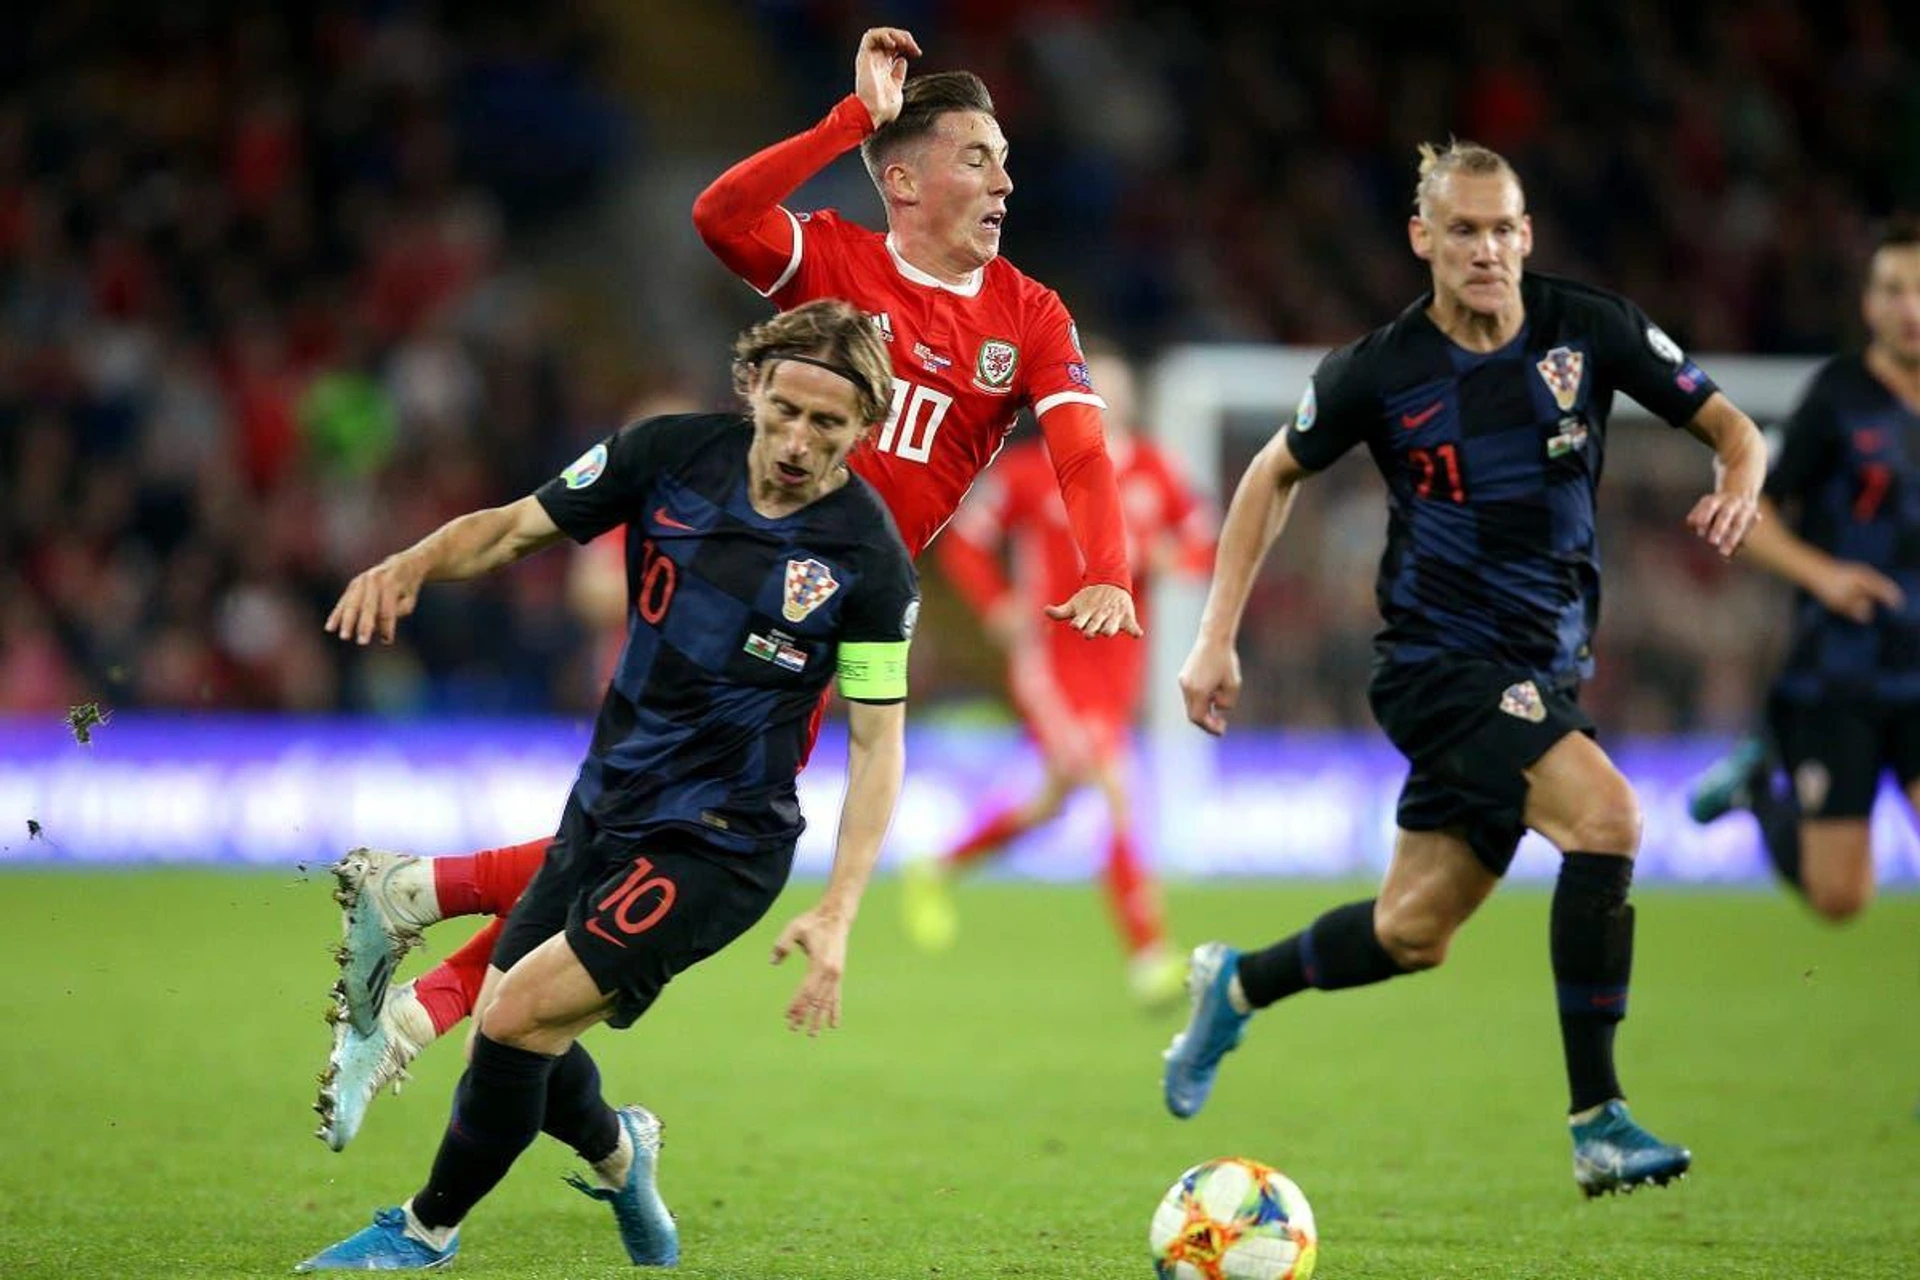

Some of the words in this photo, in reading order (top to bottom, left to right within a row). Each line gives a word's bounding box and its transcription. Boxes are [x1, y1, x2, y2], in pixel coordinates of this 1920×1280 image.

[877, 377, 953, 464] 10
[1408, 444, 1464, 504] 21
[639, 538, 676, 624] 10
[597, 856, 677, 934] 10
